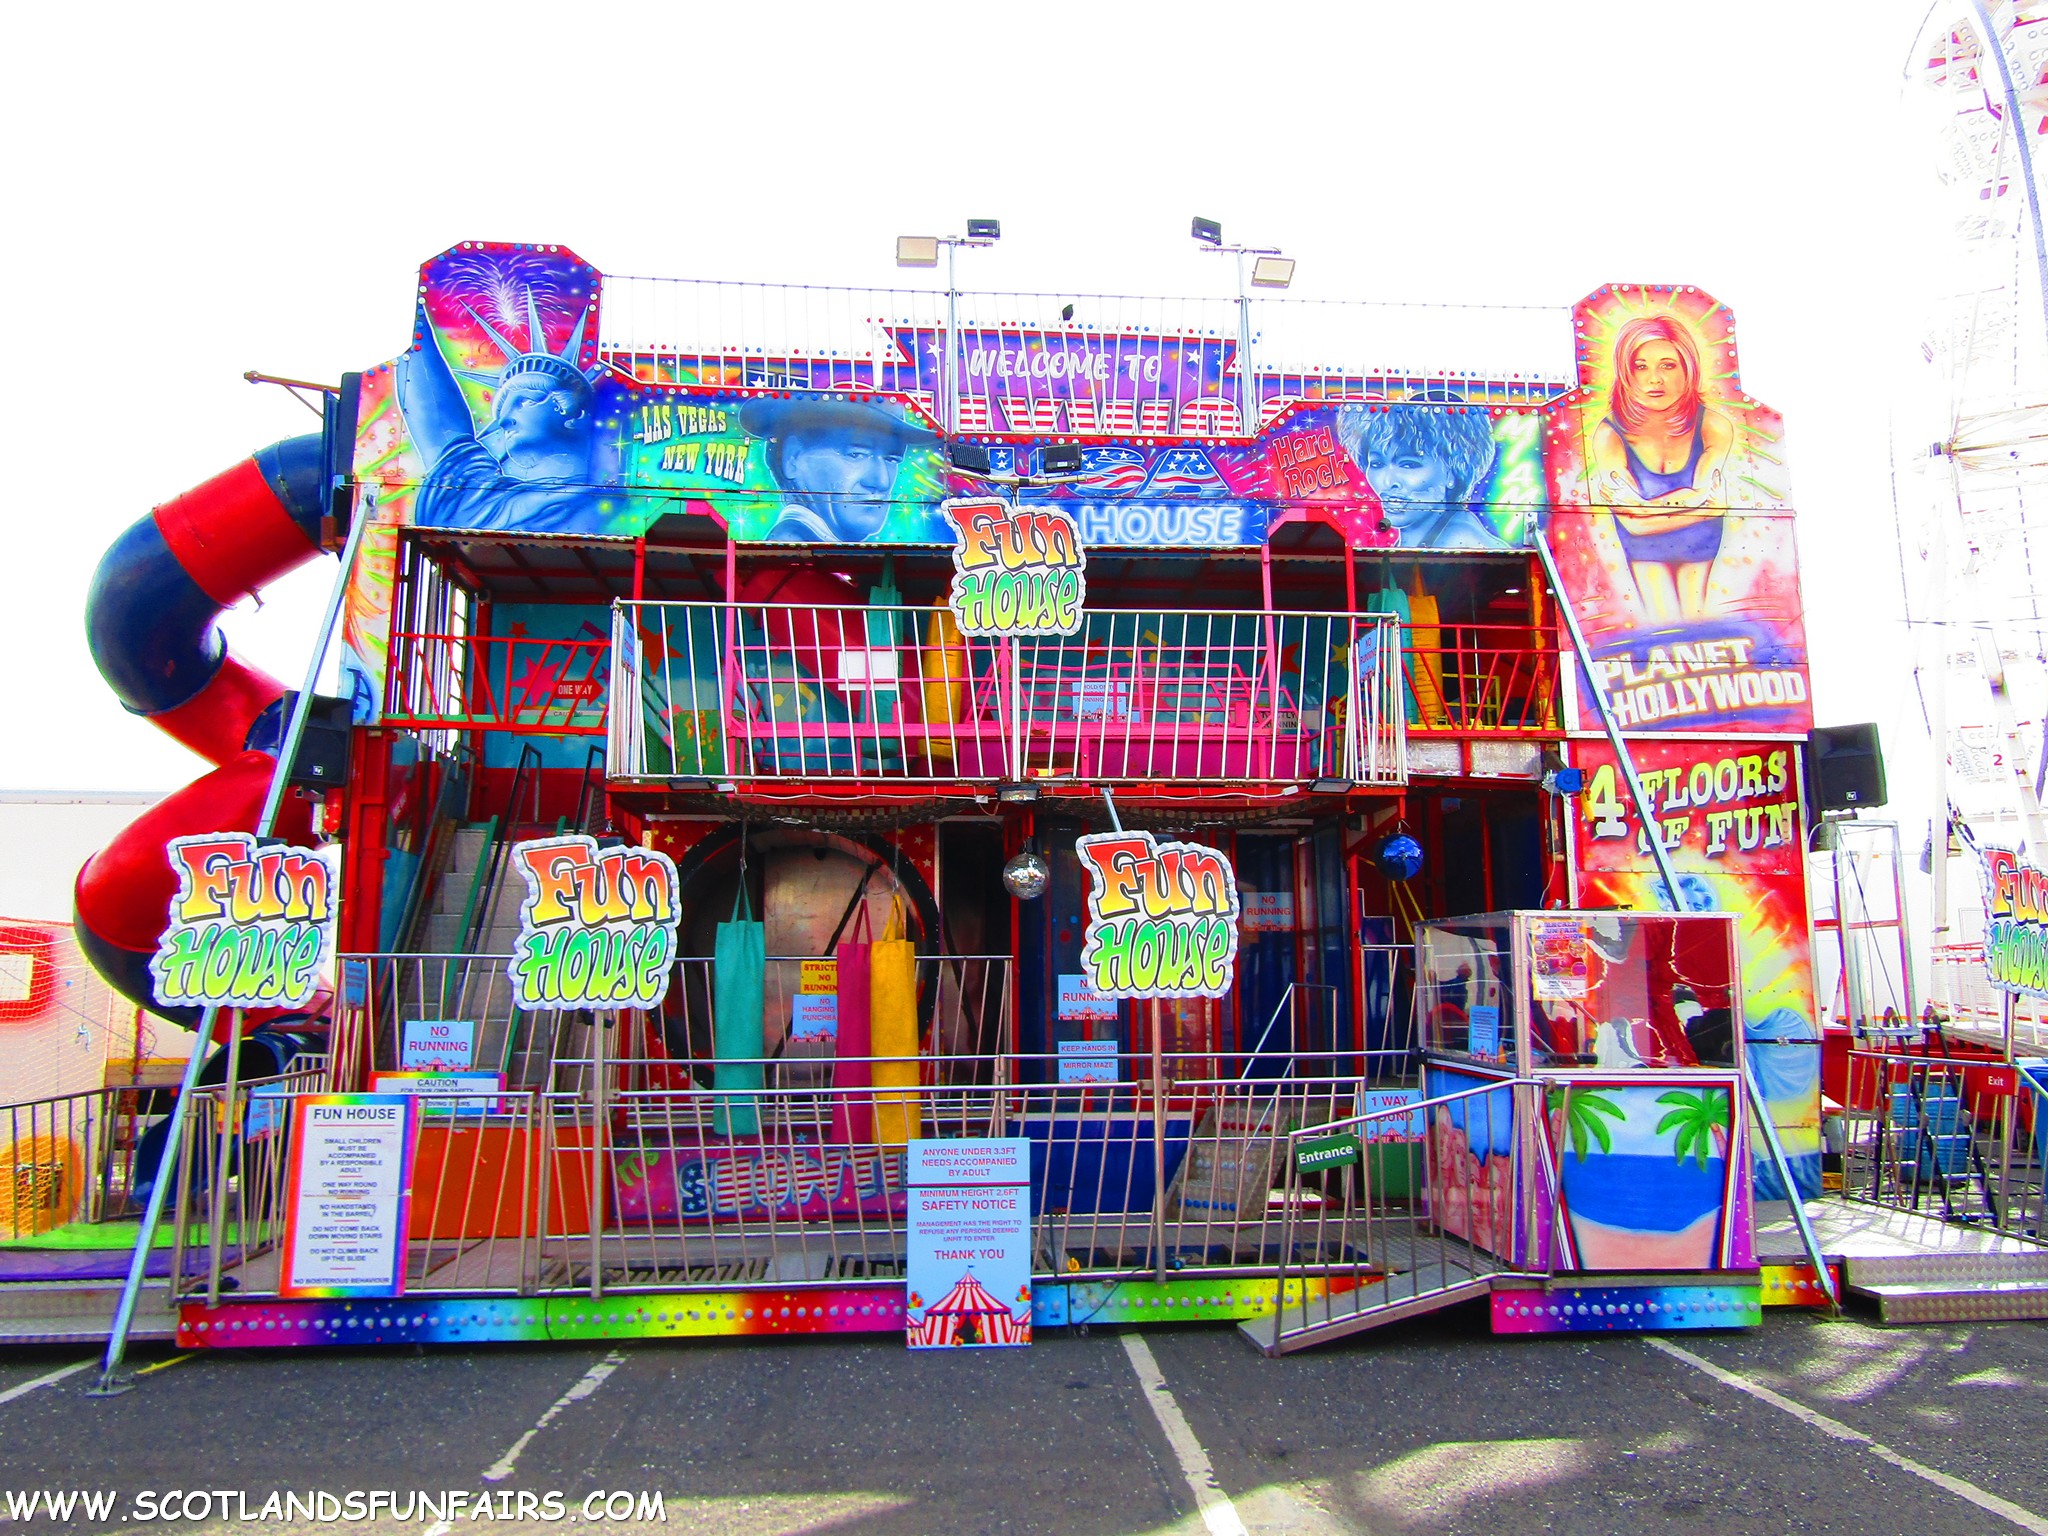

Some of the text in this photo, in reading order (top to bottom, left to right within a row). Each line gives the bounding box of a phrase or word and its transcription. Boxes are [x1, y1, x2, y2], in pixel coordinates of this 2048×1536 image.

[970, 348, 1162, 383] WELCOME TO
[642, 405, 728, 445] LAS VEGAS
[1272, 426, 1335, 468] Hard
[661, 443, 749, 485] NEW YORK
[1283, 453, 1350, 498] Rock
[1080, 504, 1243, 545] HOUSE
[947, 503, 1081, 571] Fun
[1593, 637, 1753, 691] PLANET
[557, 684, 574, 695] ONE
[1612, 670, 1807, 728] HOLLYWOOD
[1588, 750, 1788, 838] 4 FLOORS
[1706, 802, 1798, 855] FUN
[177, 841, 331, 925] Fun
[521, 844, 675, 929] Fun
[1084, 838, 1234, 920] Fun
[1261, 895, 1276, 905] NO
[1247, 907, 1292, 916] RUNNING
[1988, 921, 2048, 993] Hous
[803, 984, 838, 992] RUNNIN
[430, 1026, 449, 1037] NO
[409, 1041, 468, 1052] RUNNING
[417, 1079, 459, 1087] CAUTION
[1988, 1075, 2004, 1086] Exit
[1381, 1096, 1408, 1106] WAY
[314, 1108, 397, 1120] FUN HOUSE
[923, 1147, 1017, 1156] ANYONE UNDER 3.3FT
[1298, 1145, 1354, 1164] Entrance
[922, 1157, 1018, 1167] NEEDS ACCOMPANIED
[948, 1168, 991, 1177] BY ADULT
[919, 1189, 959, 1197] MINIMUM
[961, 1189, 994, 1197] HEIGHT
[922, 1199, 1017, 1211] SAFETY NOTICE
[934, 1249, 1005, 1260] THANK YOU
